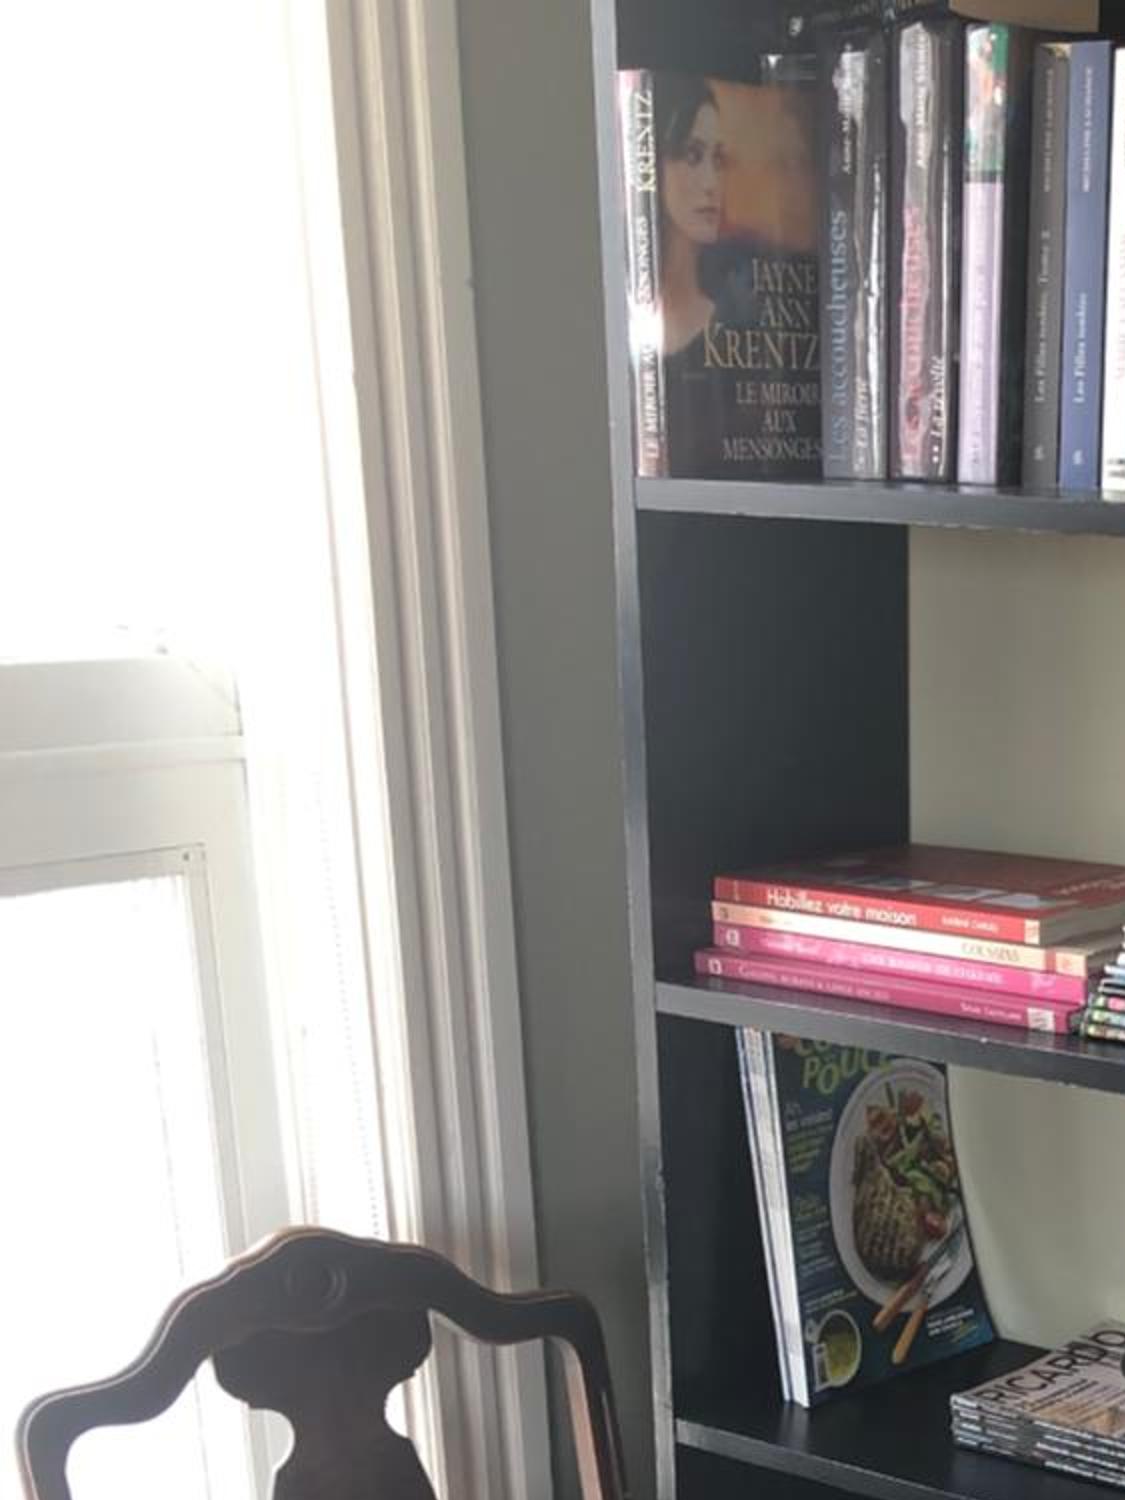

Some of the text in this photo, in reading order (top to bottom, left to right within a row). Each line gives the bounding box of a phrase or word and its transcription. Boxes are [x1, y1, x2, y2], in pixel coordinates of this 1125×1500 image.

[752, 258, 817, 297] JAYNE
[760, 301, 812, 329] ANN
[825, 209, 848, 407] accoucheuses
[704, 320, 819, 370] KRENTZ
[736, 384, 758, 405] LE
[762, 410, 797, 432] AUX
[766, 888, 822, 917] Habillez
[865, 906, 917, 928] maison
